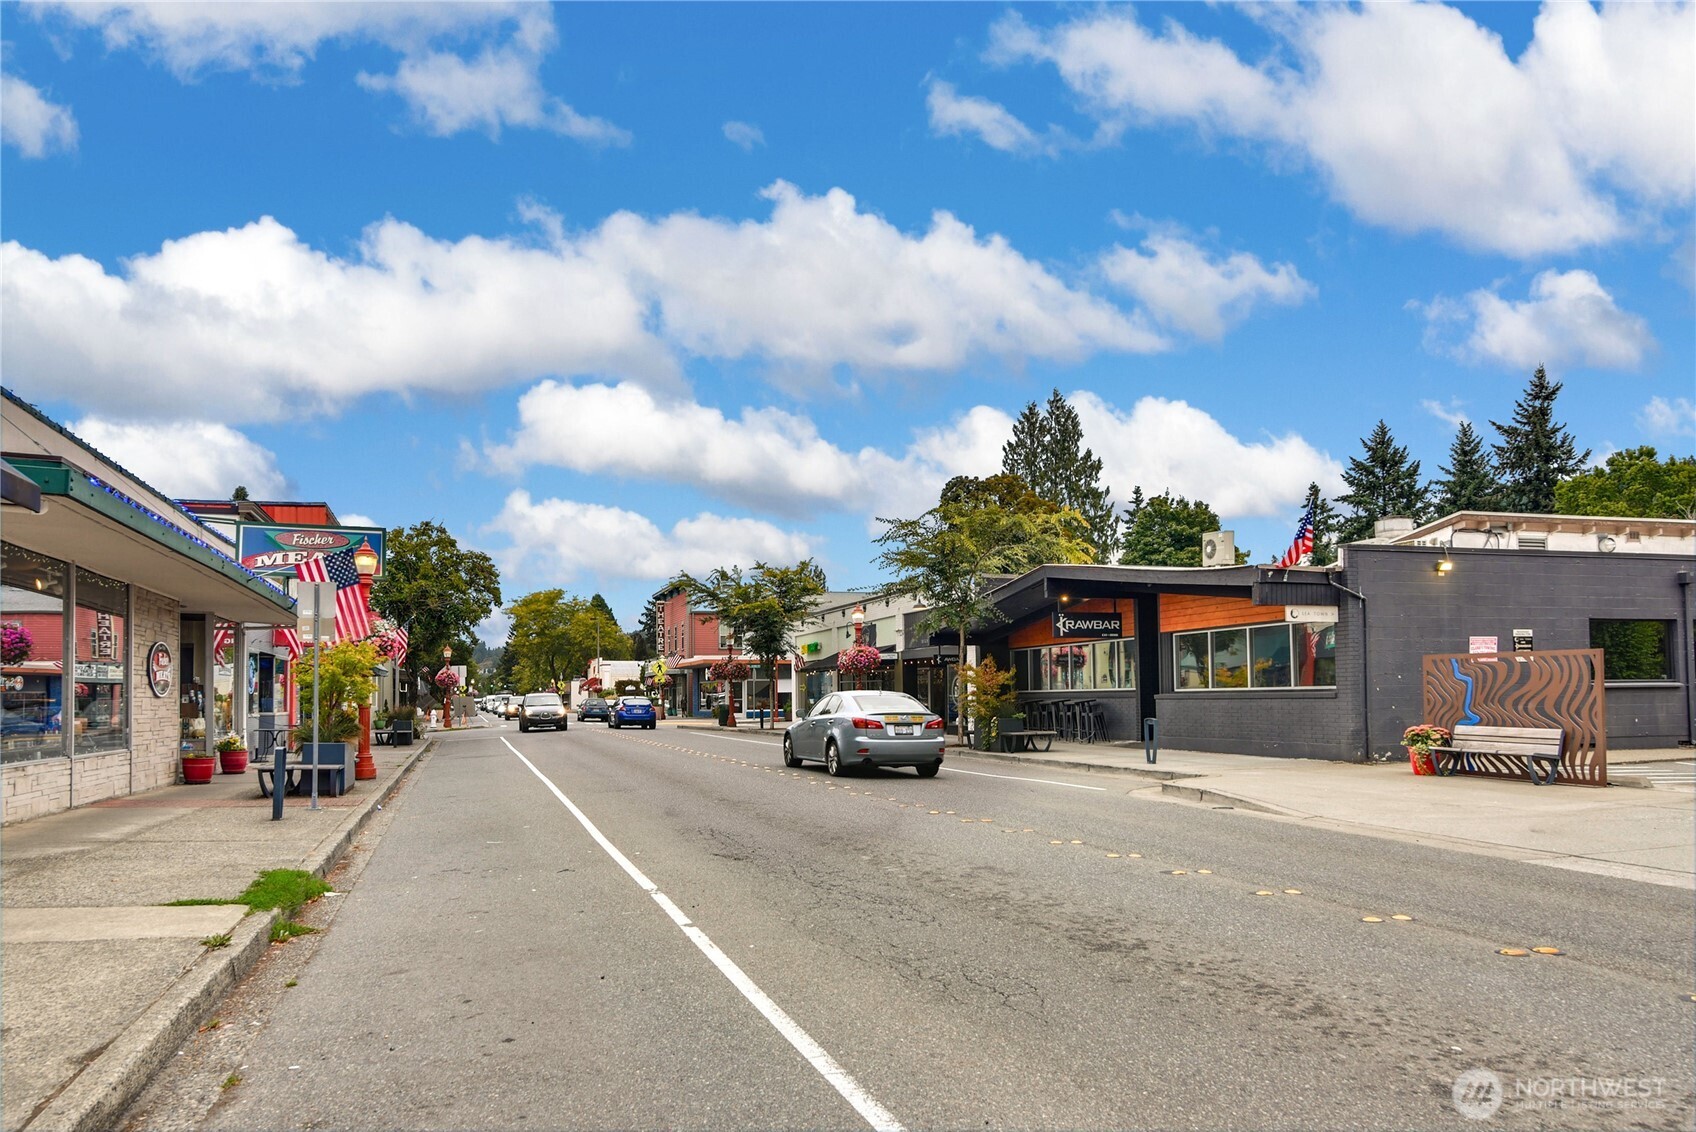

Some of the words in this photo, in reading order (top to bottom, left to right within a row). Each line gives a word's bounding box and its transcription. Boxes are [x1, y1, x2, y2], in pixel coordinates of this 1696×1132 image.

[292, 533, 334, 545] Fischer
[254, 551, 325, 567] MEA
[657, 605, 665, 651] THEATRE
